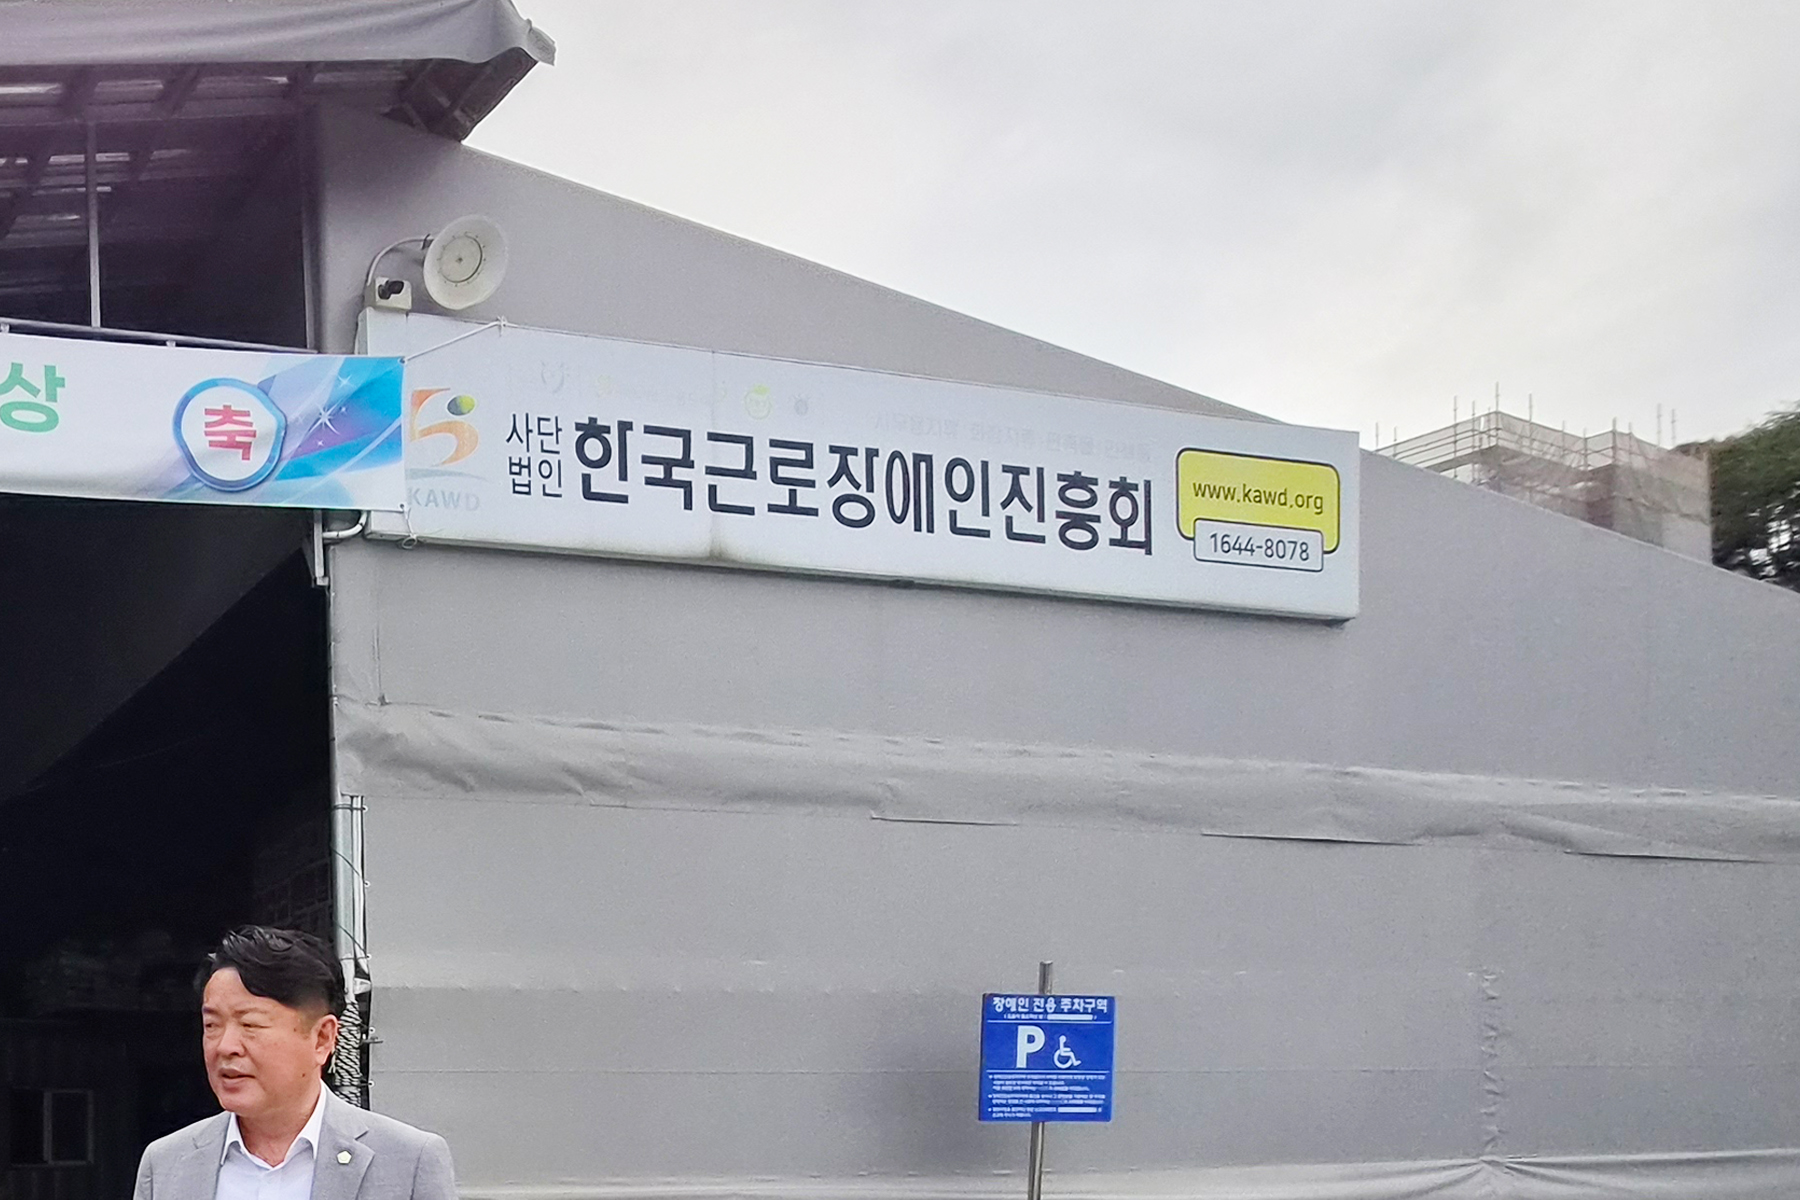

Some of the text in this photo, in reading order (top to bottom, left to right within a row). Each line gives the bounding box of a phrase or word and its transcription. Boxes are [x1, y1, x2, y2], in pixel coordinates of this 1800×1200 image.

[204, 405, 257, 461] 축
[505, 412, 563, 455] 사단
[508, 456, 563, 498] 법인
[574, 416, 1153, 557] 한국근로장애인진흥회
[1192, 481, 1324, 515] www.kawd.org
[407, 487, 480, 511] KAWD
[1210, 532, 1310, 562] 1644-8078
[992, 997, 1108, 1013] 장애인 전용 주차구역
[1016, 1025, 1046, 1069] P
